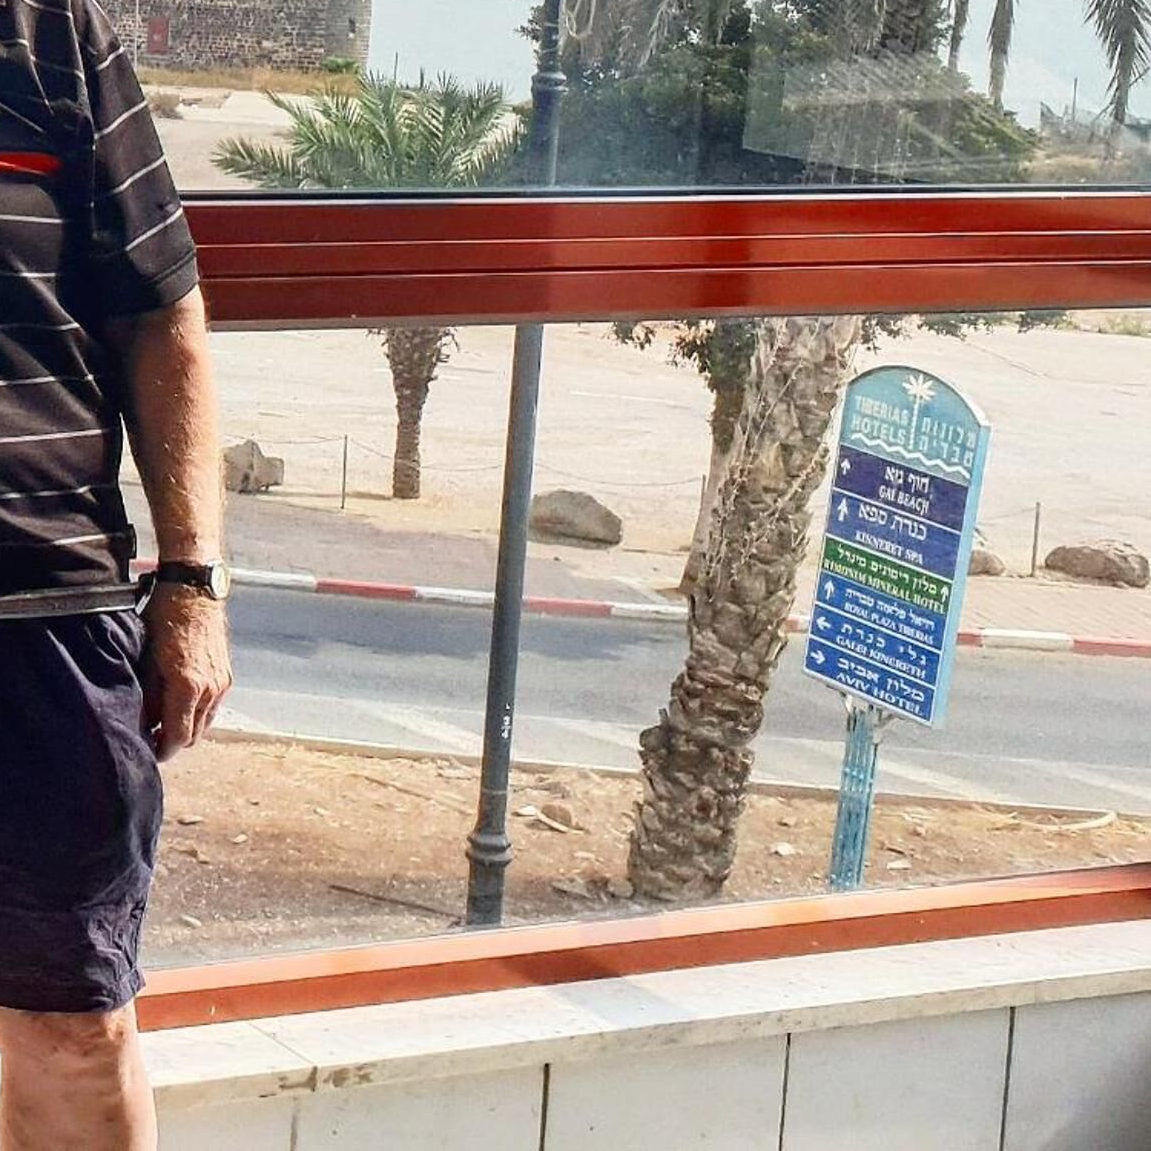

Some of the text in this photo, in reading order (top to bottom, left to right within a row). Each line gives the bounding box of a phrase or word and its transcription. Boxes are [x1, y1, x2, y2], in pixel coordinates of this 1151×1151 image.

[855, 396, 911, 426] TIBERIAS
[851, 415, 907, 445] HOTELS
[921, 417, 977, 448] מלונות
[920, 437, 973, 467] טבריה
[908, 473, 930, 493] חוף
[897, 491, 930, 515] BEACH
[858, 503, 927, 541] כנרת ספא
[905, 549, 924, 565] SPA
[823, 558, 946, 615] RIMONIM MINERAL HOTEL
[913, 575, 938, 594] מלון
[844, 602, 934, 645] ROYAL PLAZA TIBERIAS
[841, 623, 927, 666] גלי כנרת
[836, 672, 922, 715] AVIV HOTEL
[837, 657, 924, 702] מלון אביב
